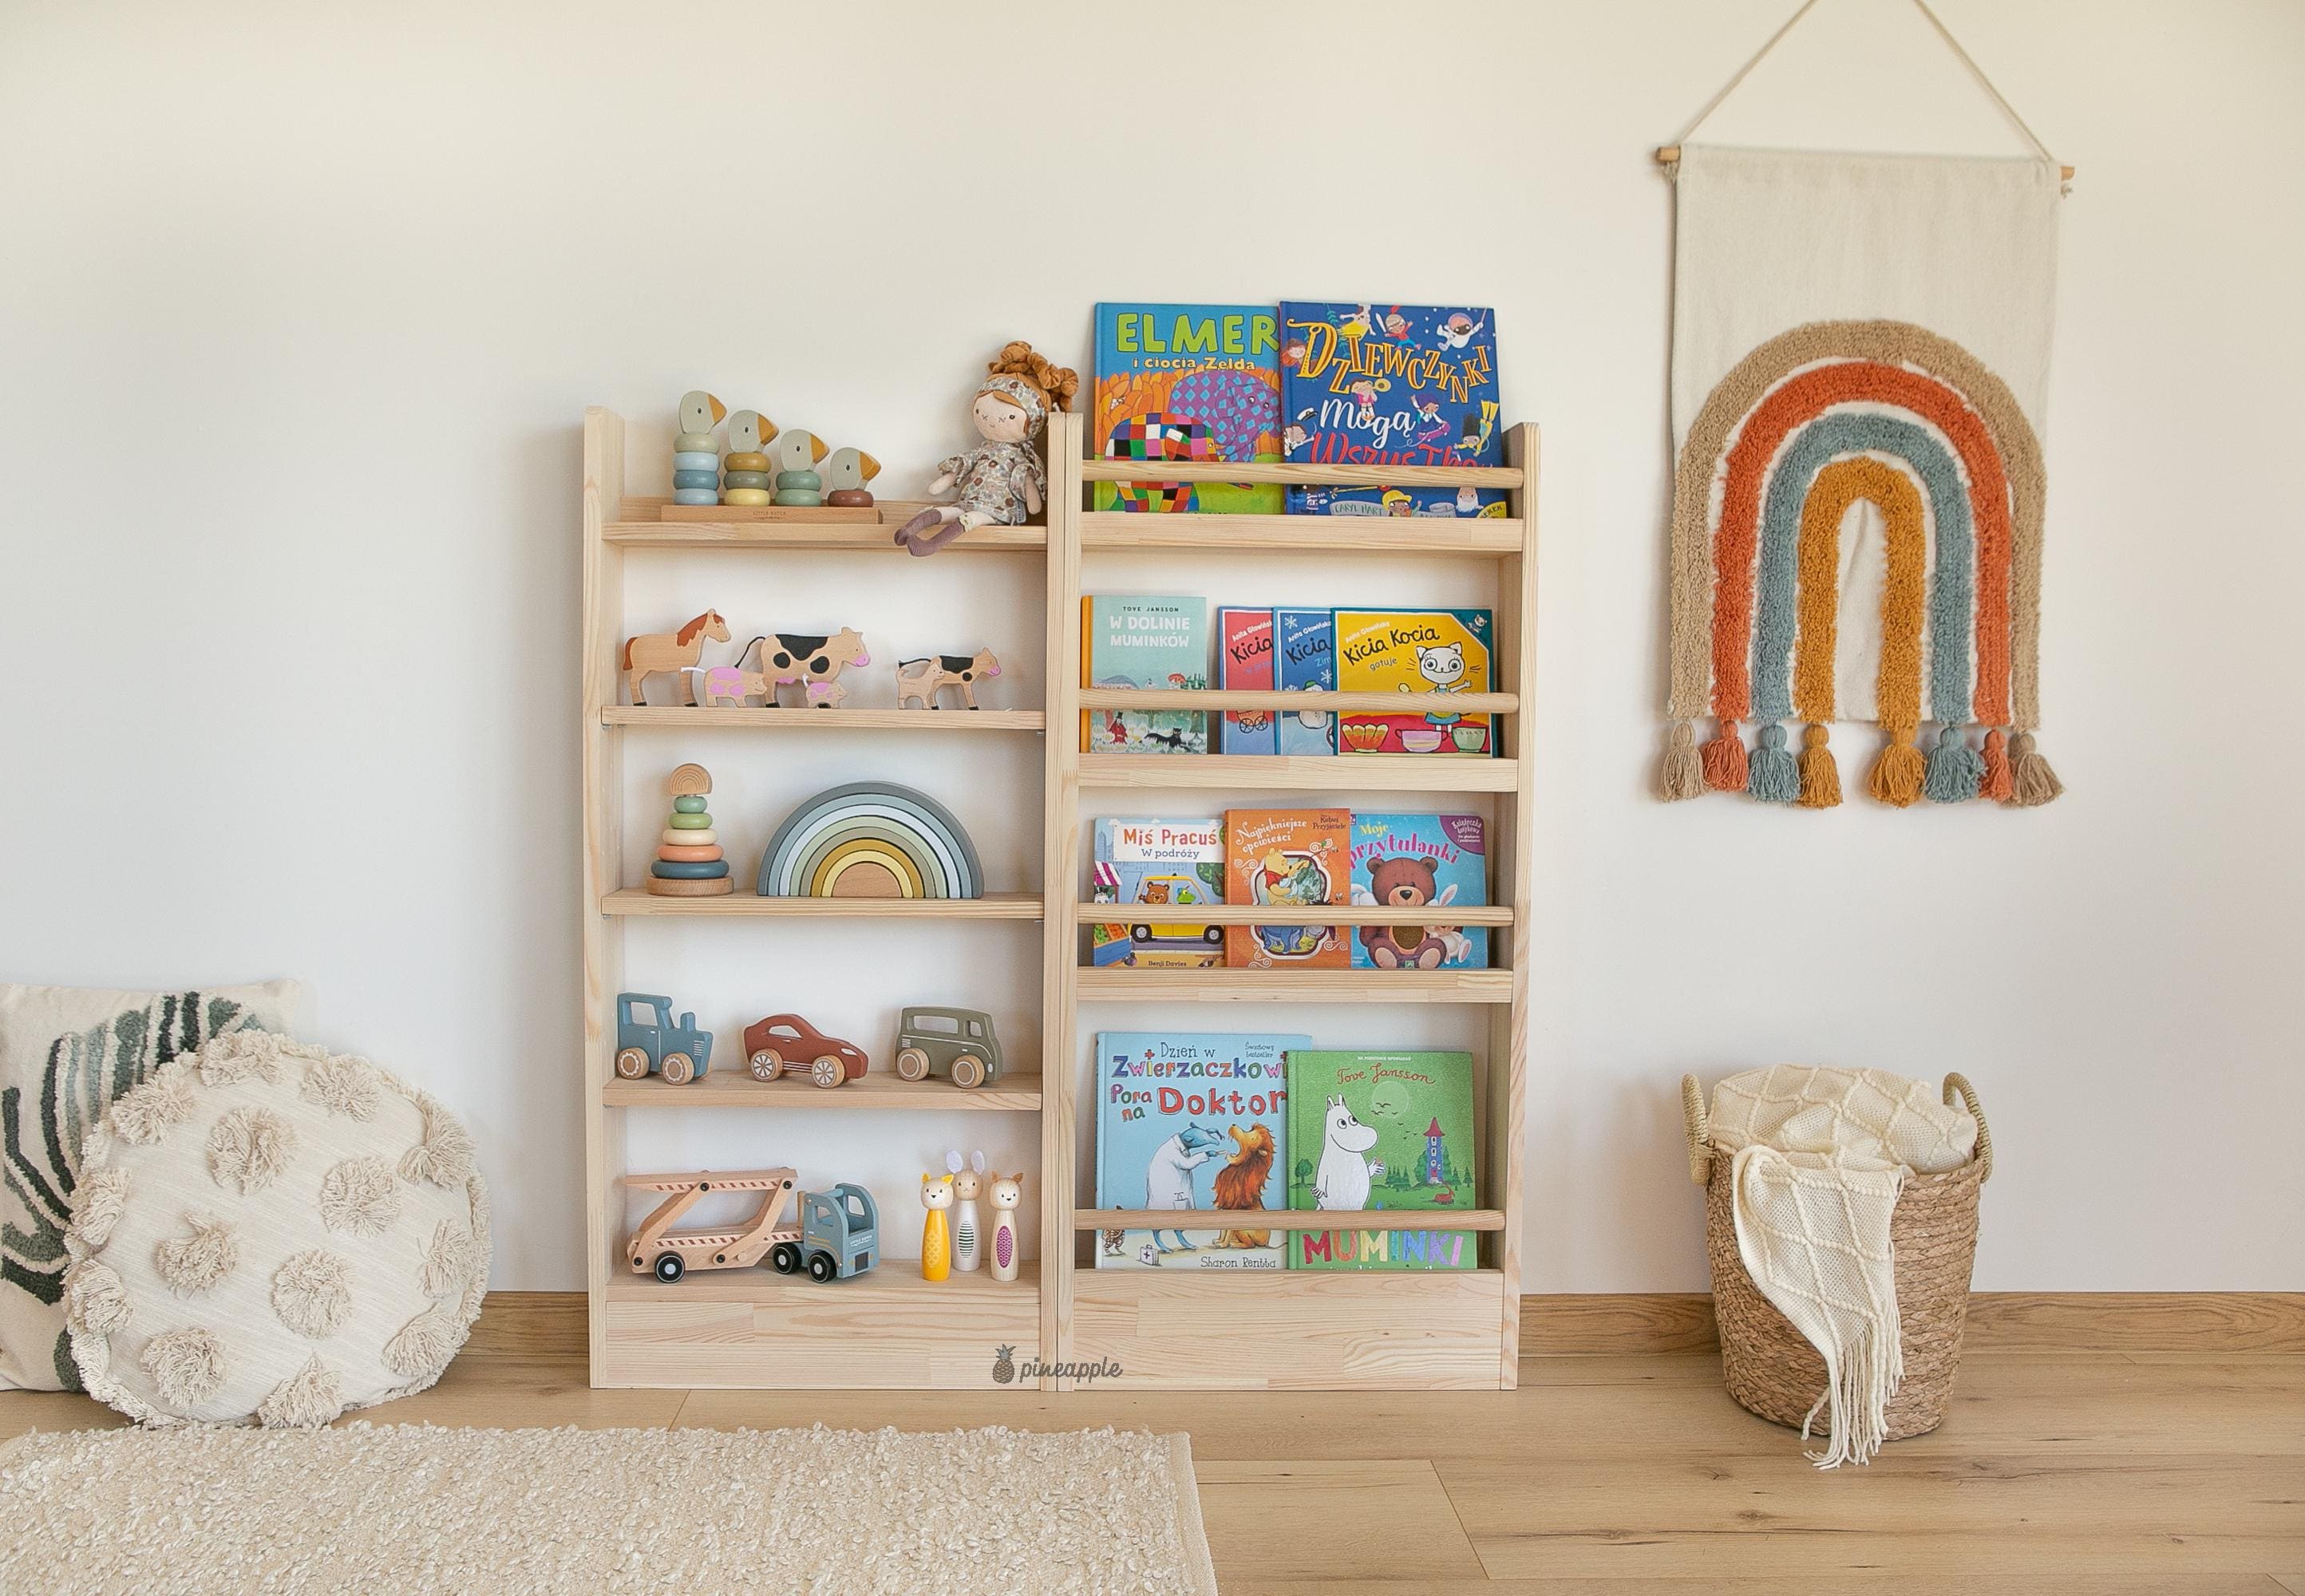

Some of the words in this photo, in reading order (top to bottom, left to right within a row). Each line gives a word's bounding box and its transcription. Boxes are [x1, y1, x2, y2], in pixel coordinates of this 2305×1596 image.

[1117, 313, 1279, 355] ELMER
[1133, 357, 1139, 369] i
[1144, 357, 1196, 369] ciocia
[1204, 357, 1256, 370] Zelda
[1109, 615, 1123, 630] W
[1127, 616, 1190, 630] DOLINIE
[1110, 632, 1190, 647] MUMINKÓW
[1231, 636, 1272, 664] Kicia
[1343, 638, 1390, 666] Kicia
[1390, 625, 1441, 648] Kocia
[1286, 637, 1330, 666] Kicia
[1370, 658, 1398, 671] gotuje
[1123, 828, 1154, 846] Miś
[1161, 828, 1217, 846] Pracuś
[1236, 817, 1307, 845] Najpiękniejsze
[1359, 822, 1390, 838] Moje
[1141, 848, 1152, 857] W
[1155, 848, 1200, 860] podróży
[1242, 832, 1291, 855] opowieści
[1350, 833, 1461, 870] przytulanki
[1160, 1042, 1198, 1058] Dzień
[1204, 1049, 1216, 1058] w
[1111, 1049, 1288, 1078] Zwierzaczkowi
[1337, 1067, 1367, 1085] Tove
[1370, 1062, 1436, 1084] Jansson
[1110, 1084, 1153, 1104] Pora
[1157, 1087, 1288, 1116] Doktor
[1122, 1106, 1145, 1122] na
[1302, 1230, 1464, 1267] MUMINKI
[1200, 1256, 1238, 1268] Sharon
[1242, 1256, 1277, 1268] Rentta
